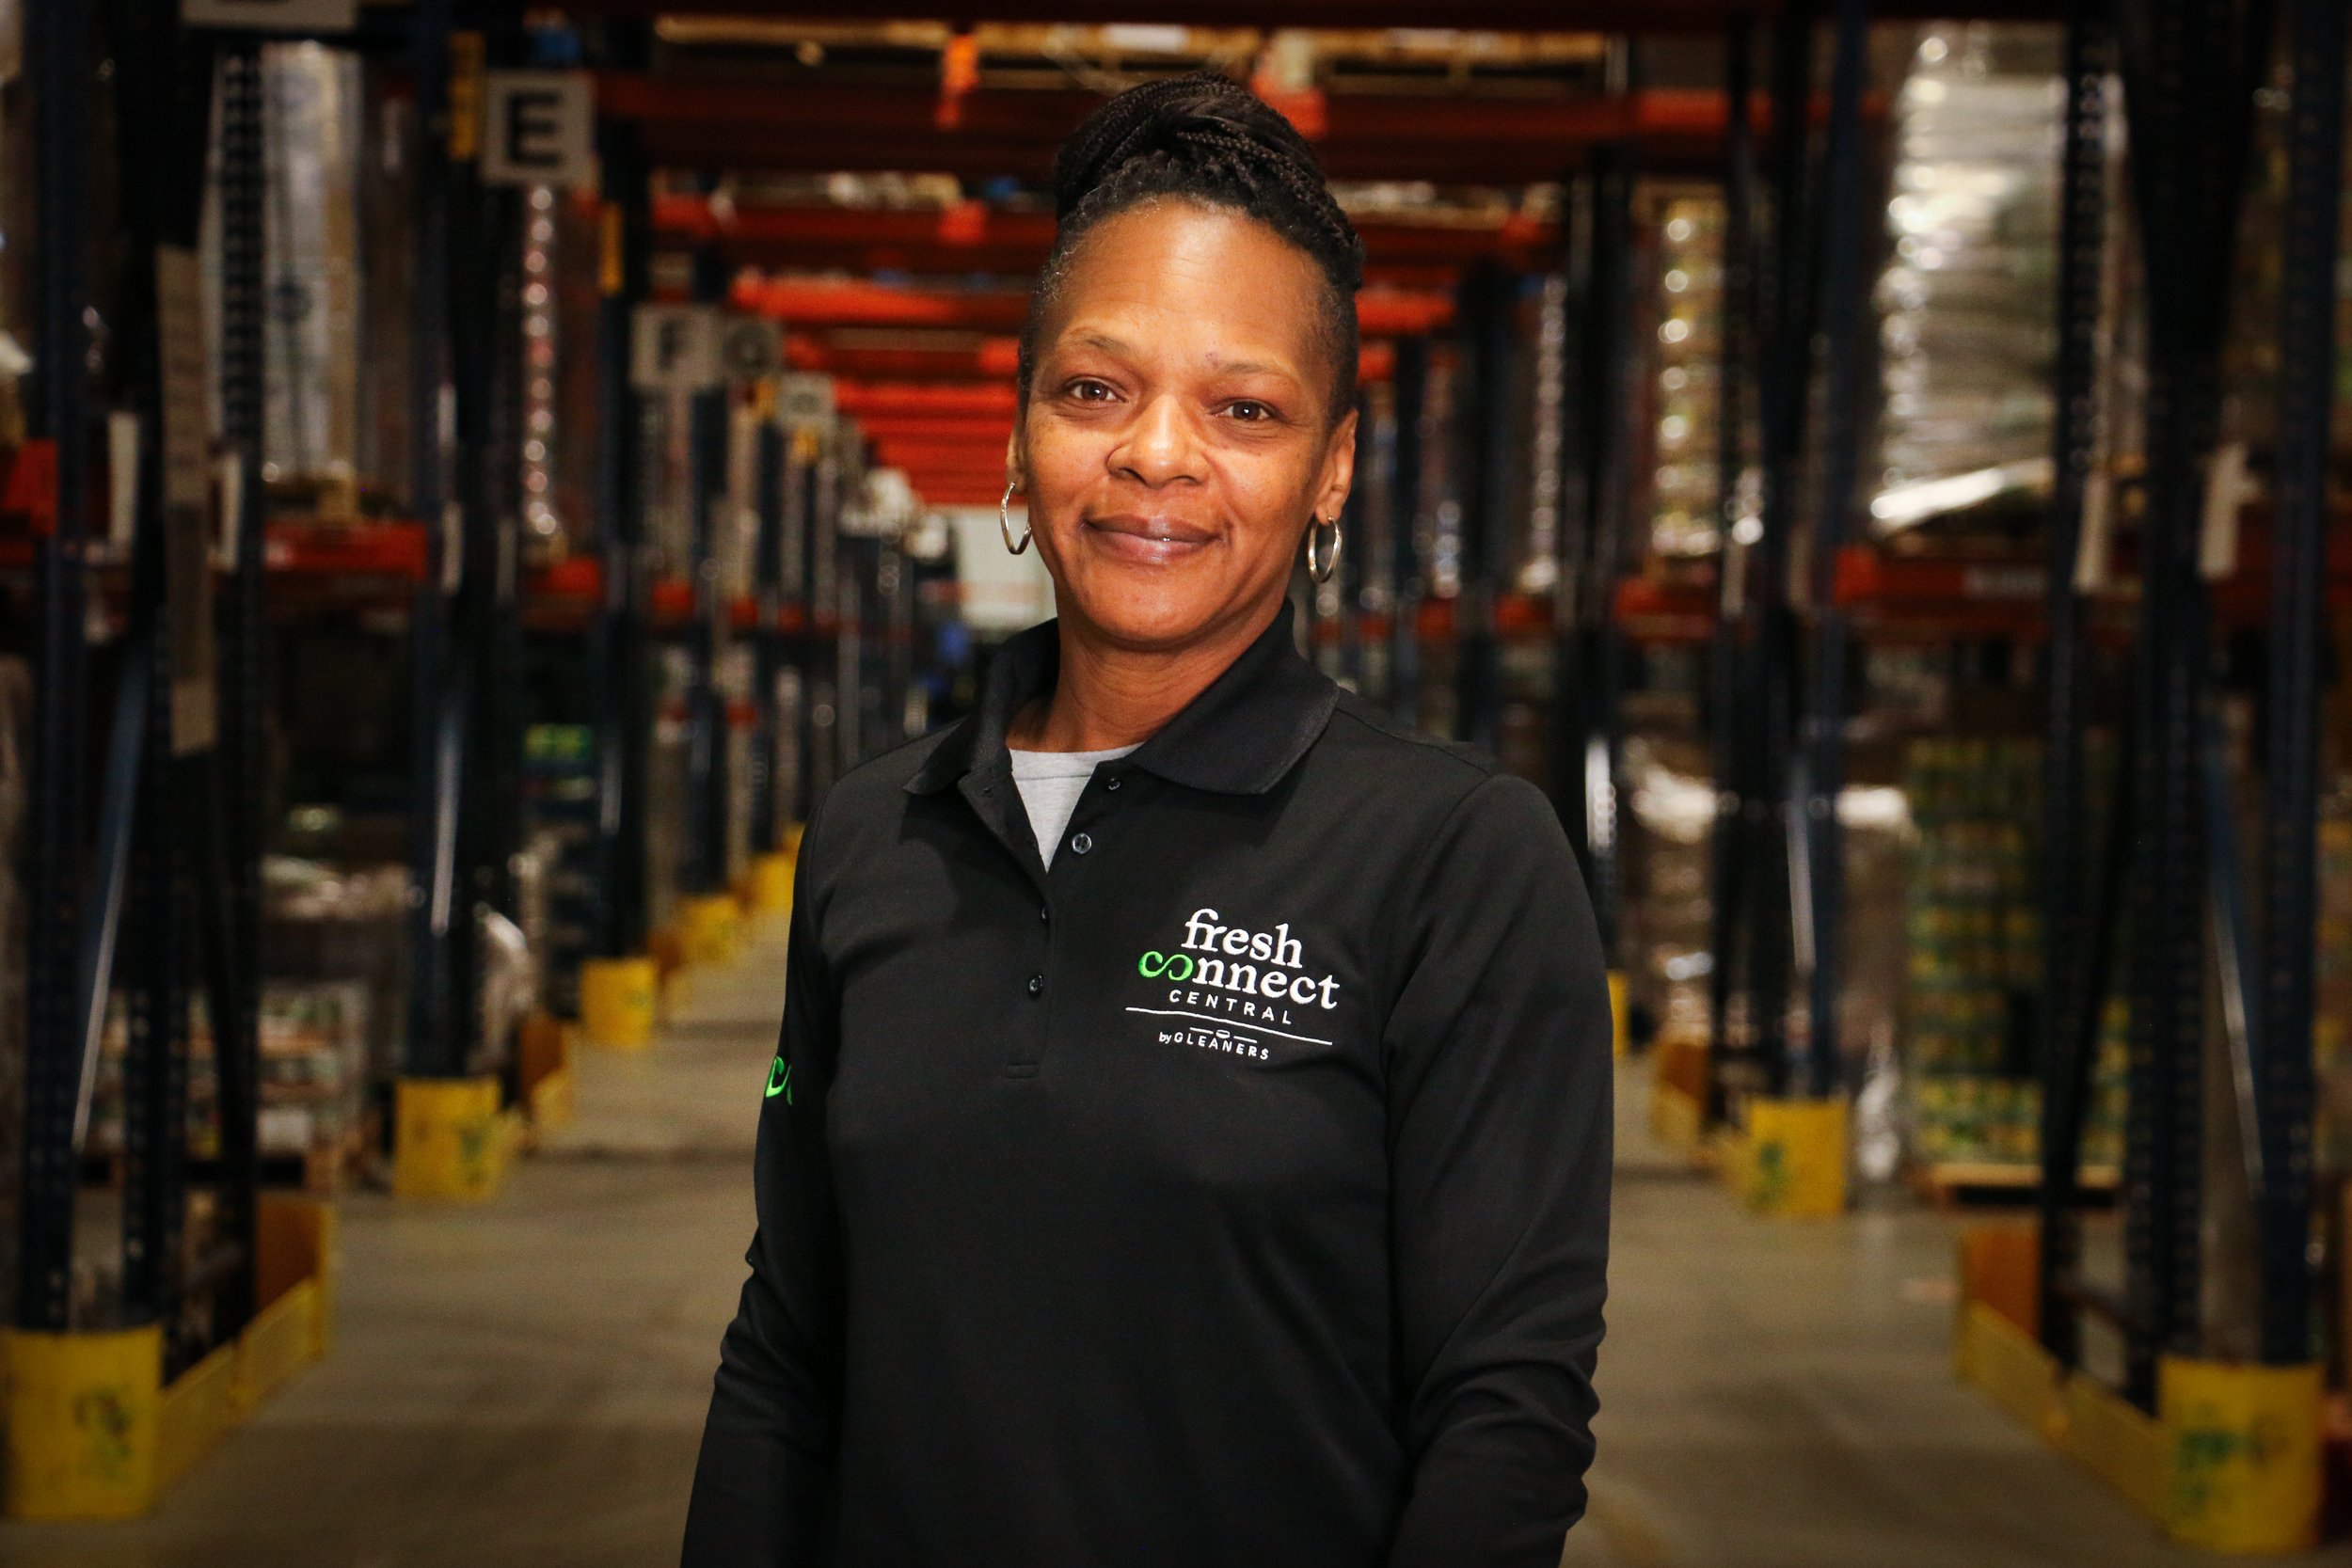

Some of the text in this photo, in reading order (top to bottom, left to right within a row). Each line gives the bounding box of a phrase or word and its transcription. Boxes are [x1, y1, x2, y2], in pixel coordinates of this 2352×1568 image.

[508, 91, 561, 166] E
[1180, 908, 1304, 969] fresh
[1137, 950, 1341, 1010] connect
[1168, 989, 1293, 1025] CENTRAL
